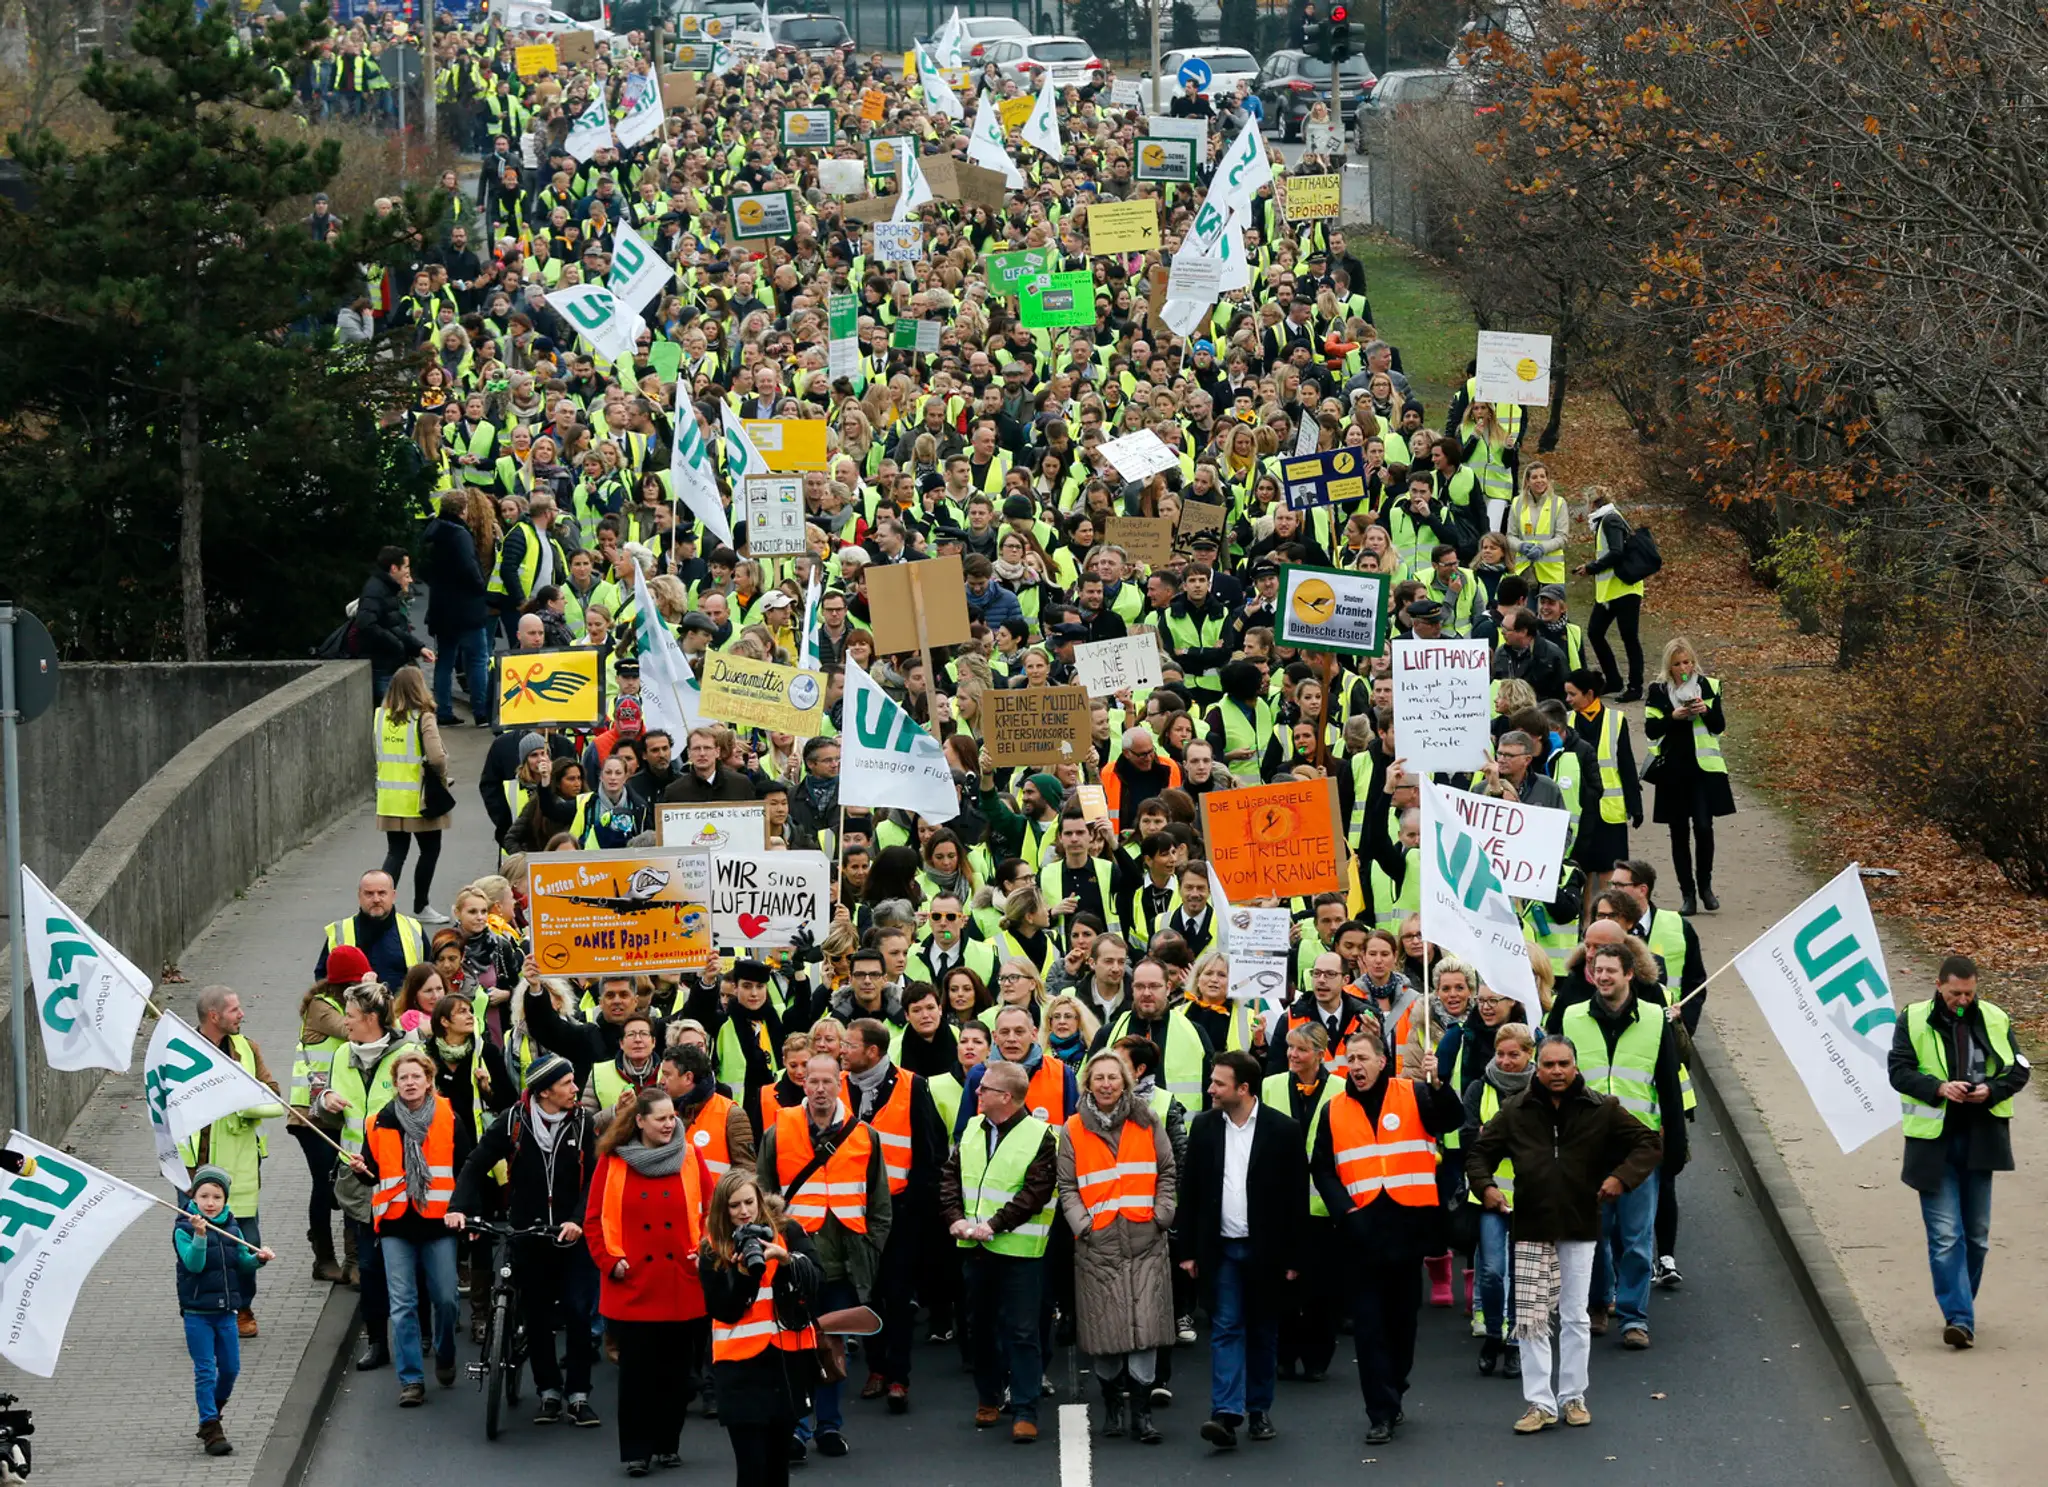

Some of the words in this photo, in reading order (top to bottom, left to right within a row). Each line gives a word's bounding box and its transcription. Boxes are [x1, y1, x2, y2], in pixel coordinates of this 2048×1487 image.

[1288, 176, 1340, 190] LUFTHANSA
[876, 225, 910, 237] SPOHR
[879, 240, 895, 250] NO
[887, 249, 922, 260] MORE!
[750, 539, 782, 552] NONSTOP
[1335, 604, 1372, 618] Kranich
[1290, 623, 1336, 637] Diebische
[1338, 628, 1371, 640] Elster?
[1137, 638, 1151, 648] ist
[1102, 655, 1124, 673] NIE
[1403, 648, 1487, 670] LUFTHANSA
[1092, 675, 1128, 690] MEHR
[1401, 681, 1418, 692] Ich
[994, 695, 1038, 712] DEINE
[1042, 694, 1087, 711] MUDDA
[995, 714, 1038, 728] KRIEGT
[1041, 713, 1068, 726] KEINE
[1402, 712, 1423, 721] und
[1430, 709, 1449, 720] Du
[995, 727, 1076, 740] ALTERSVORSORGE
[997, 742, 1016, 753] BEI
[1422, 736, 1462, 749] Rente
[1209, 802, 1229, 813] DIE
[664, 811, 691, 822] BITTE
[694, 810, 724, 820] GEHEN
[727, 810, 740, 819] SIE
[1214, 847, 1239, 860] DIE
[1244, 836, 1329, 858] TRIBUTE
[717, 859, 757, 889] WIR
[768, 872, 807, 888] SIND
[1222, 871, 1258, 885] VOM
[1264, 859, 1337, 884] KRANICH
[1492, 858, 1547, 888] ND!
[534, 875, 575, 896] Carsten
[712, 890, 816, 920] LUFTHANSA
[574, 930, 616, 949] DANKE
[1771, 947, 1819, 1027] Unabhängige
[1820, 1033, 1874, 1114] Flugbegleiter
